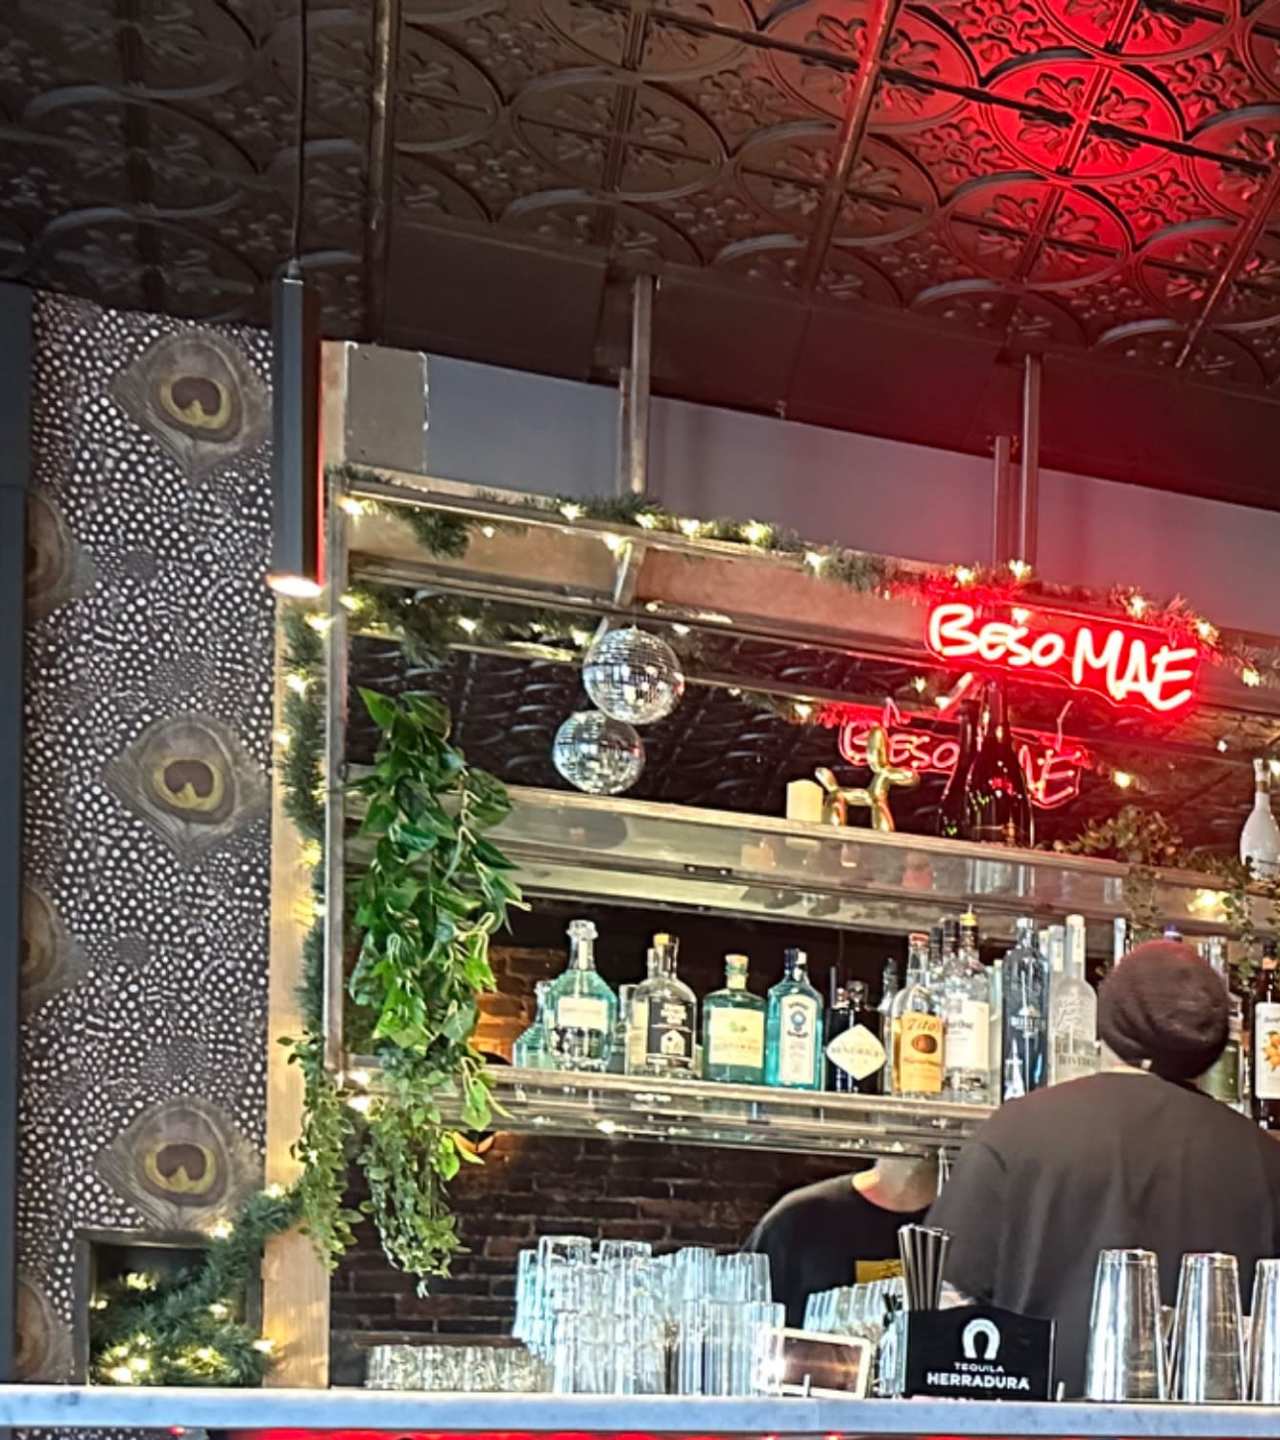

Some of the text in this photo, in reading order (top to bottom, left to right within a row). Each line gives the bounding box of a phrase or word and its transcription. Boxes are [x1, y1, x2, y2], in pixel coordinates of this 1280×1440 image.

[1072, 627, 1198, 711] MAE
[954, 1362, 1004, 1373] TEQUILA
[927, 1372, 1030, 1390] HERRADURA
